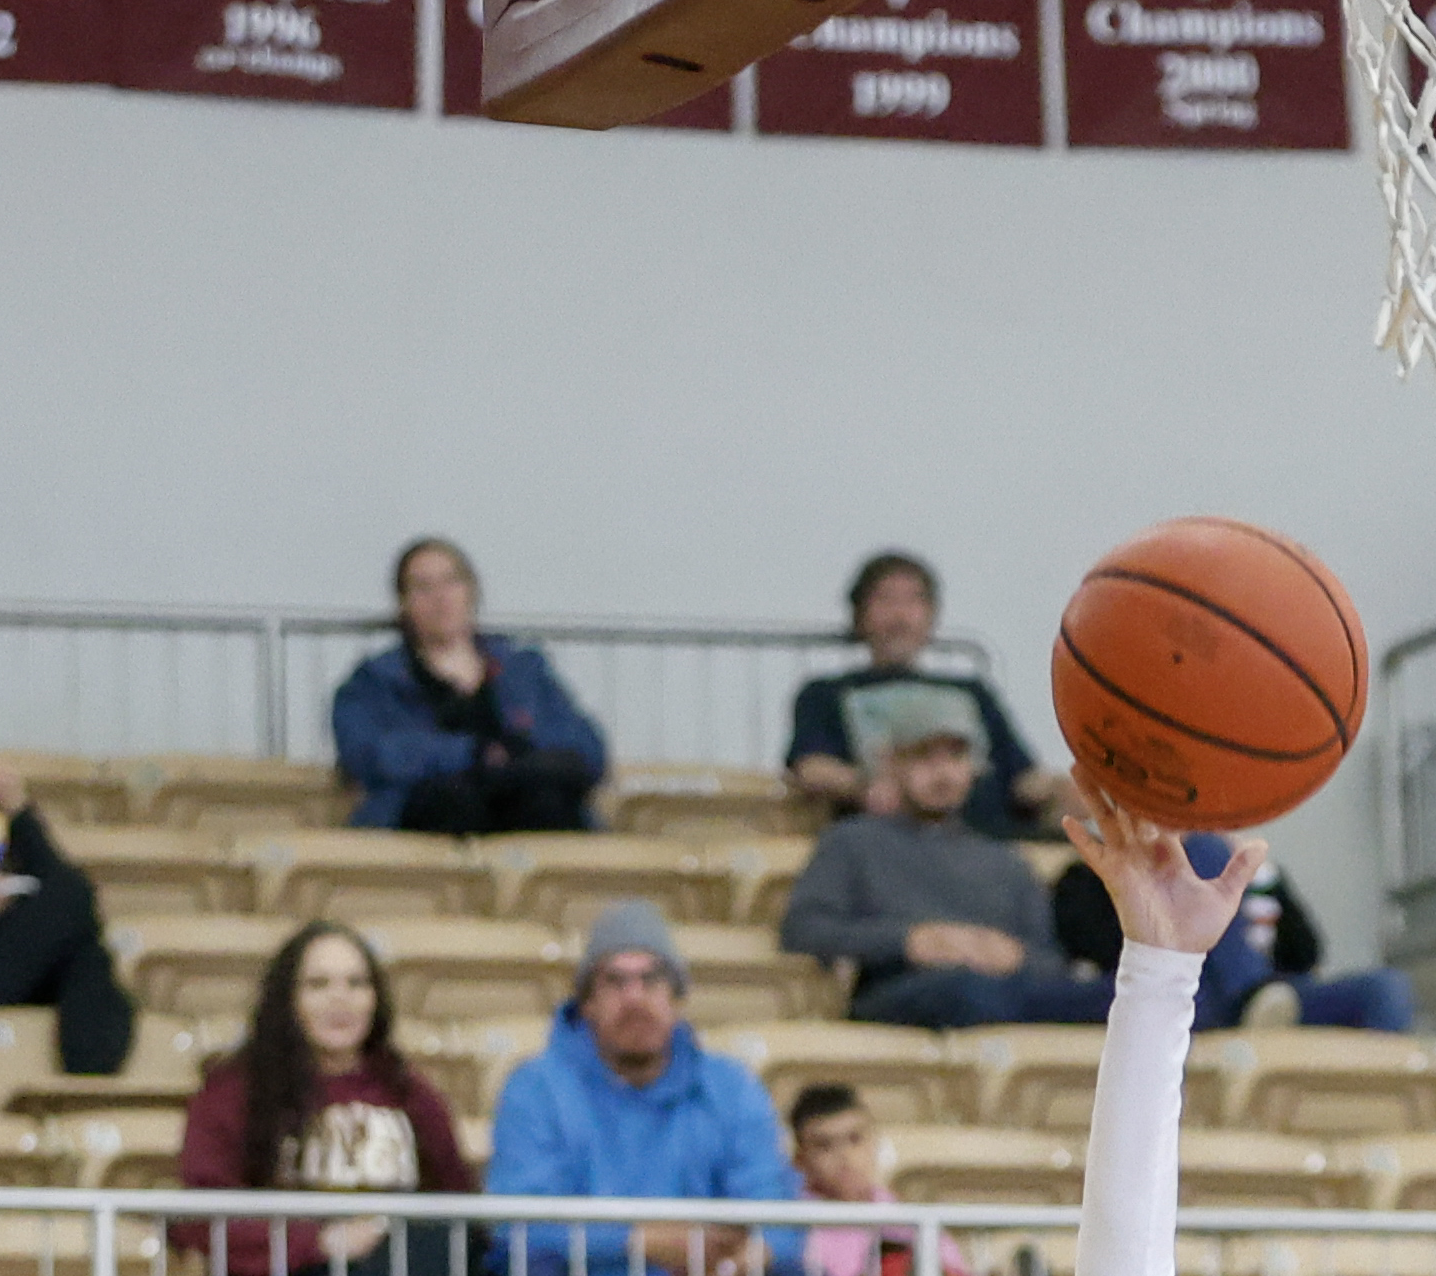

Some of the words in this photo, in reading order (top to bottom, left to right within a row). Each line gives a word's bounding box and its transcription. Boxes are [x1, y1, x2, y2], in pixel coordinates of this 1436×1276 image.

[788, 9, 1021, 64] hampions
[1085, 0, 1325, 50] Champions
[853, 70, 952, 119] 1999
